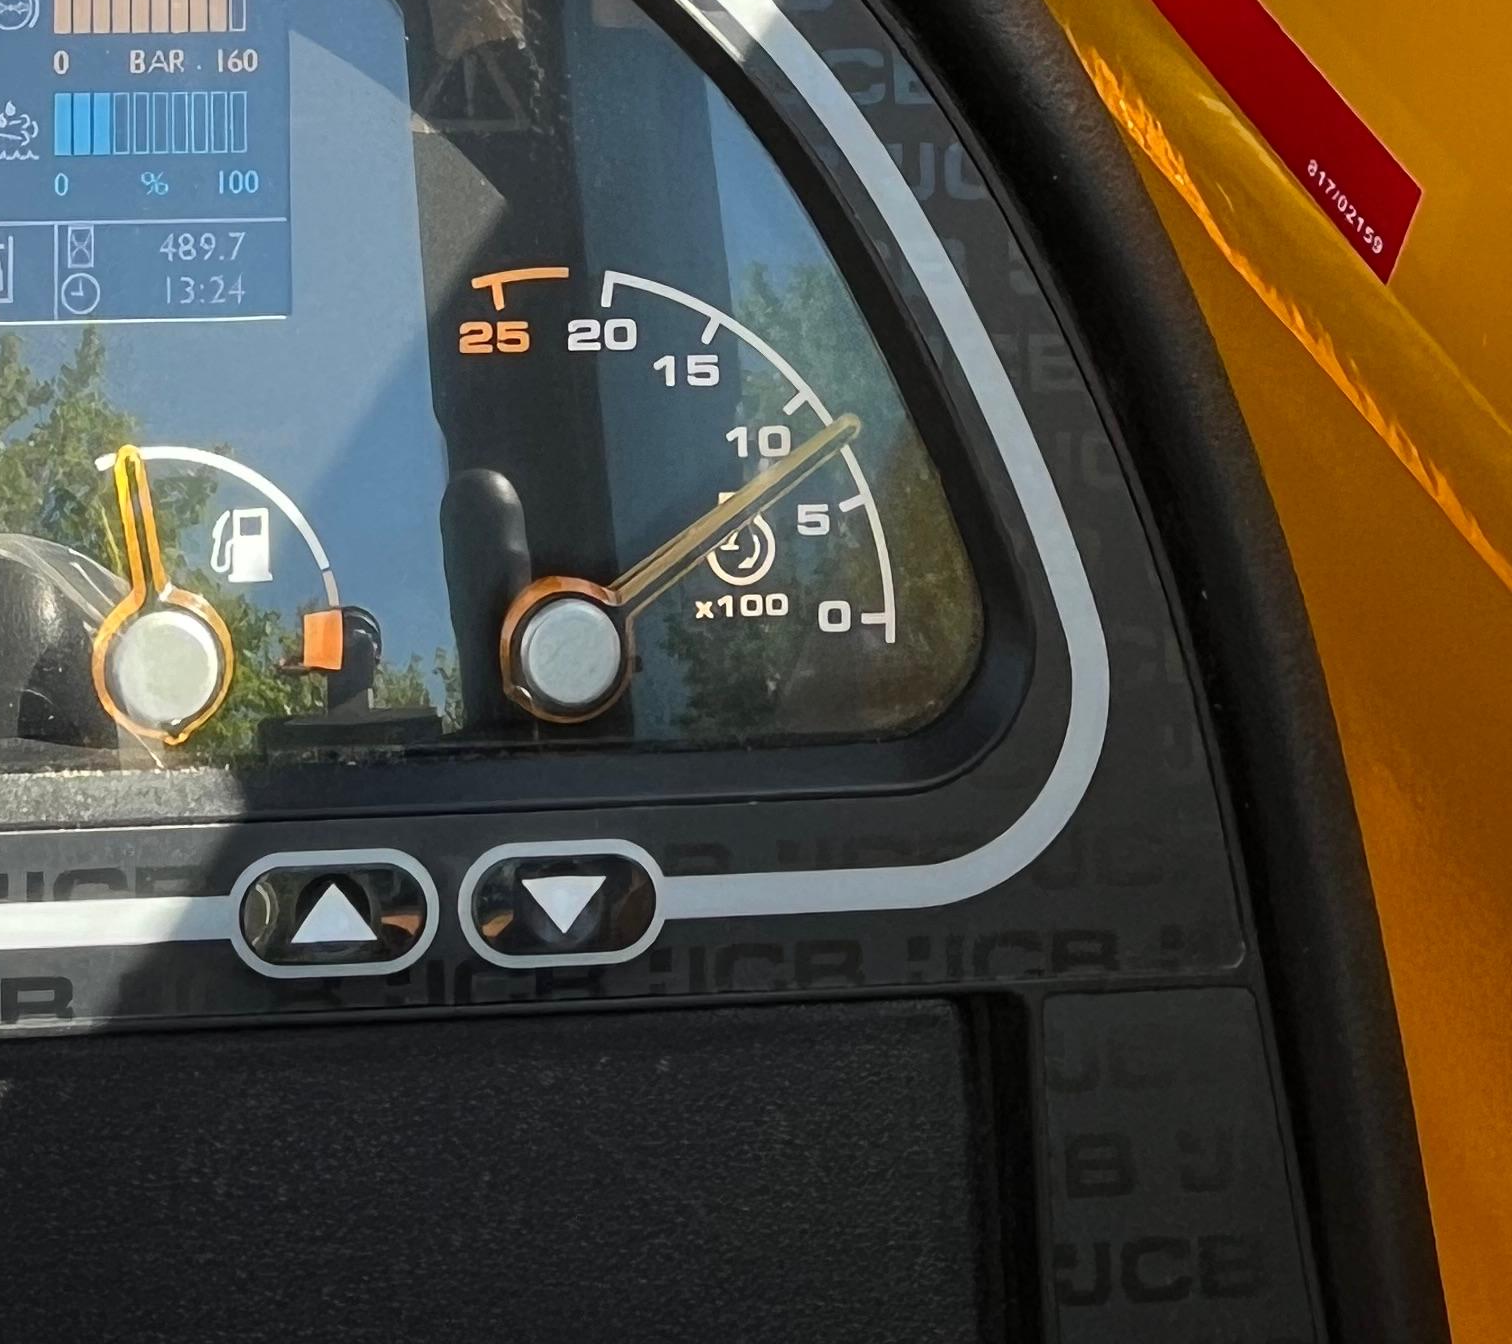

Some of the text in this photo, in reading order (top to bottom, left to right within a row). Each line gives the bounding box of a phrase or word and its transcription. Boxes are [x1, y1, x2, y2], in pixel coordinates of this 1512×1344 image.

[53, 48, 258, 75] 0 BAR 160
[54, 172, 69, 196] 0
[218, 169, 259, 194] 100
[1308, 159, 1383, 254] 817/02159
[159, 232, 247, 262] 489.7
[166, 272, 246, 305] 13:24
[459, 318, 638, 354] 25 20
[653, 354, 720, 387] 15
[725, 425, 792, 458] 10
[796, 504, 831, 536] 5
[695, 593, 851, 633] x100 0
